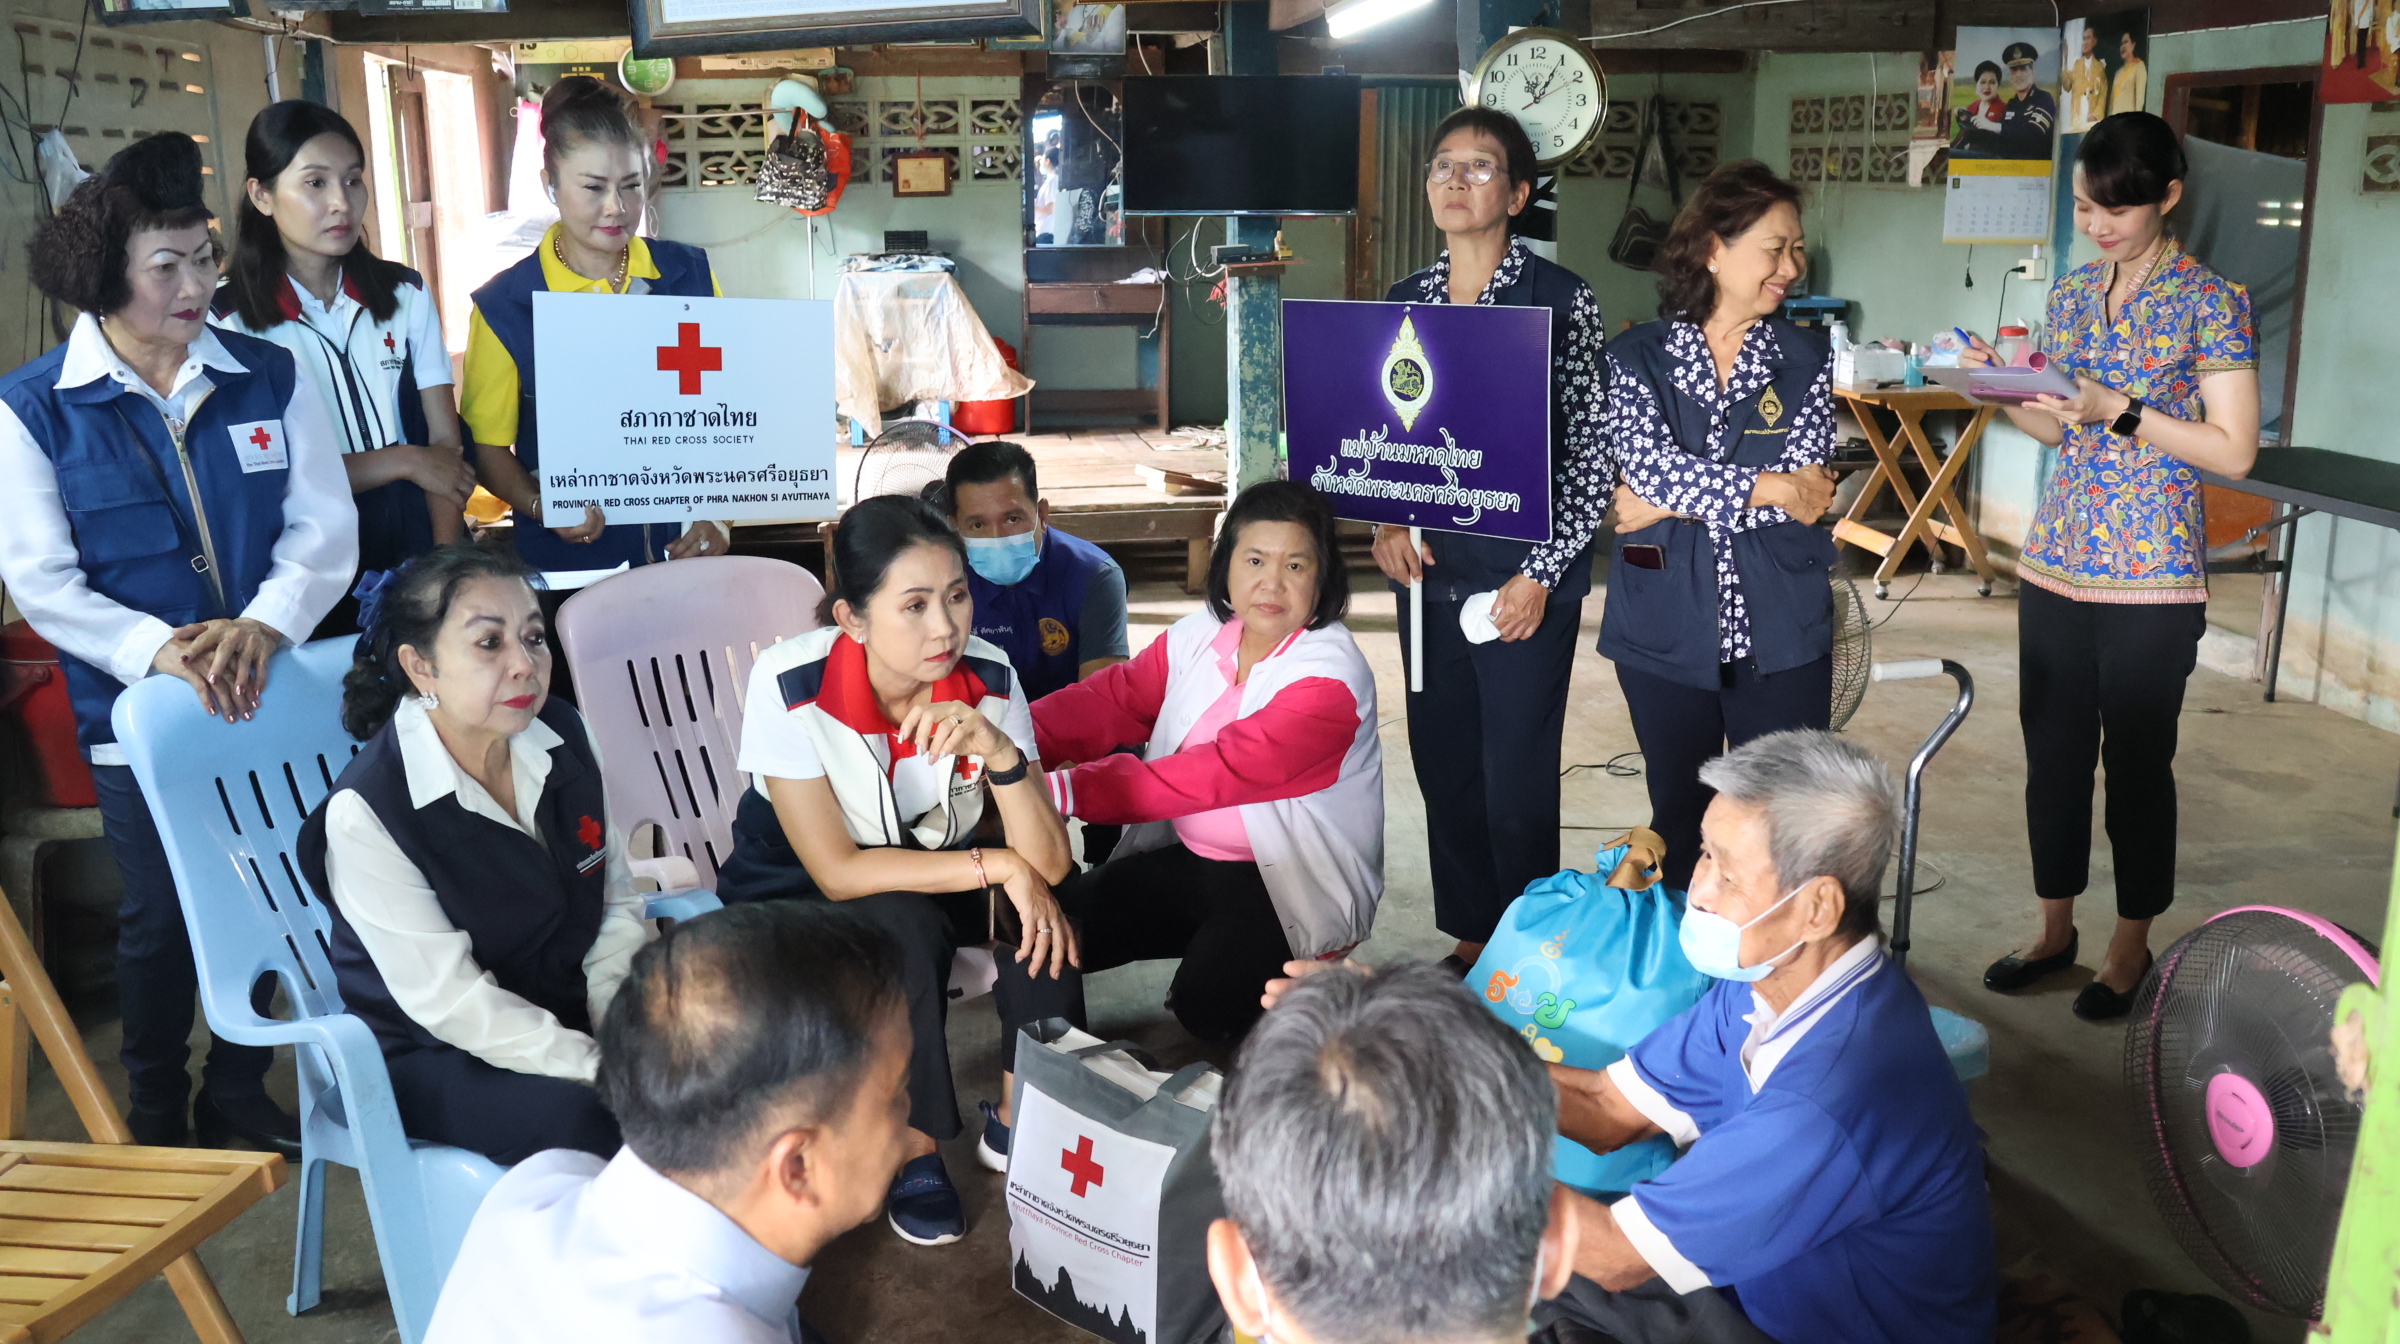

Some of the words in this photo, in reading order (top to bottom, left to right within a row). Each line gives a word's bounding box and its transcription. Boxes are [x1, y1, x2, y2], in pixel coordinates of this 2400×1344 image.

[1530, 47, 1547, 59] 12
[1507, 54, 1518, 66] 11
[1559, 54, 1565, 66] 1
[1490, 70, 1505, 83] 10
[1573, 71, 1583, 83] 2
[1486, 94, 1497, 106] 9
[1575, 94, 1587, 106] 3
[1568, 117, 1579, 129] 4
[1553, 135, 1564, 148] 5
[620, 403, 757, 428] สภากาชาดไทย
[623, 436, 647, 445] THAI
[652, 436, 671, 445] RED
[675, 435, 707, 445] CROSS
[713, 435, 755, 444] SOCIETY
[1340, 423, 1482, 469] แม่บ้านมหาดไทย
[550, 463, 829, 489] เหล่ากาชาดจังหวัดพระนครศรีอยุธยา
[1311, 455, 1521, 525] จังหวัดพระนครศรีอยุธยา
[553, 499, 602, 509] PROVINCIAL
[604, 498, 620, 507] RED
[624, 497, 650, 507] CROSS
[653, 496, 690, 506] CHAPTER
[693, 495, 704, 504] OF
[707, 494, 729, 504] PHRA
[732, 493, 768, 503] NAKHON
[771, 493, 779, 502] SI
[781, 492, 830, 502] AYUTTHAYA
[1012, 1201, 1043, 1224] Ayutthaya
[1044, 1218, 1073, 1240] Province
[1074, 1234, 1088, 1247] Red
[1089, 1241, 1110, 1256] Cross
[1111, 1250, 1143, 1267] Chapter
